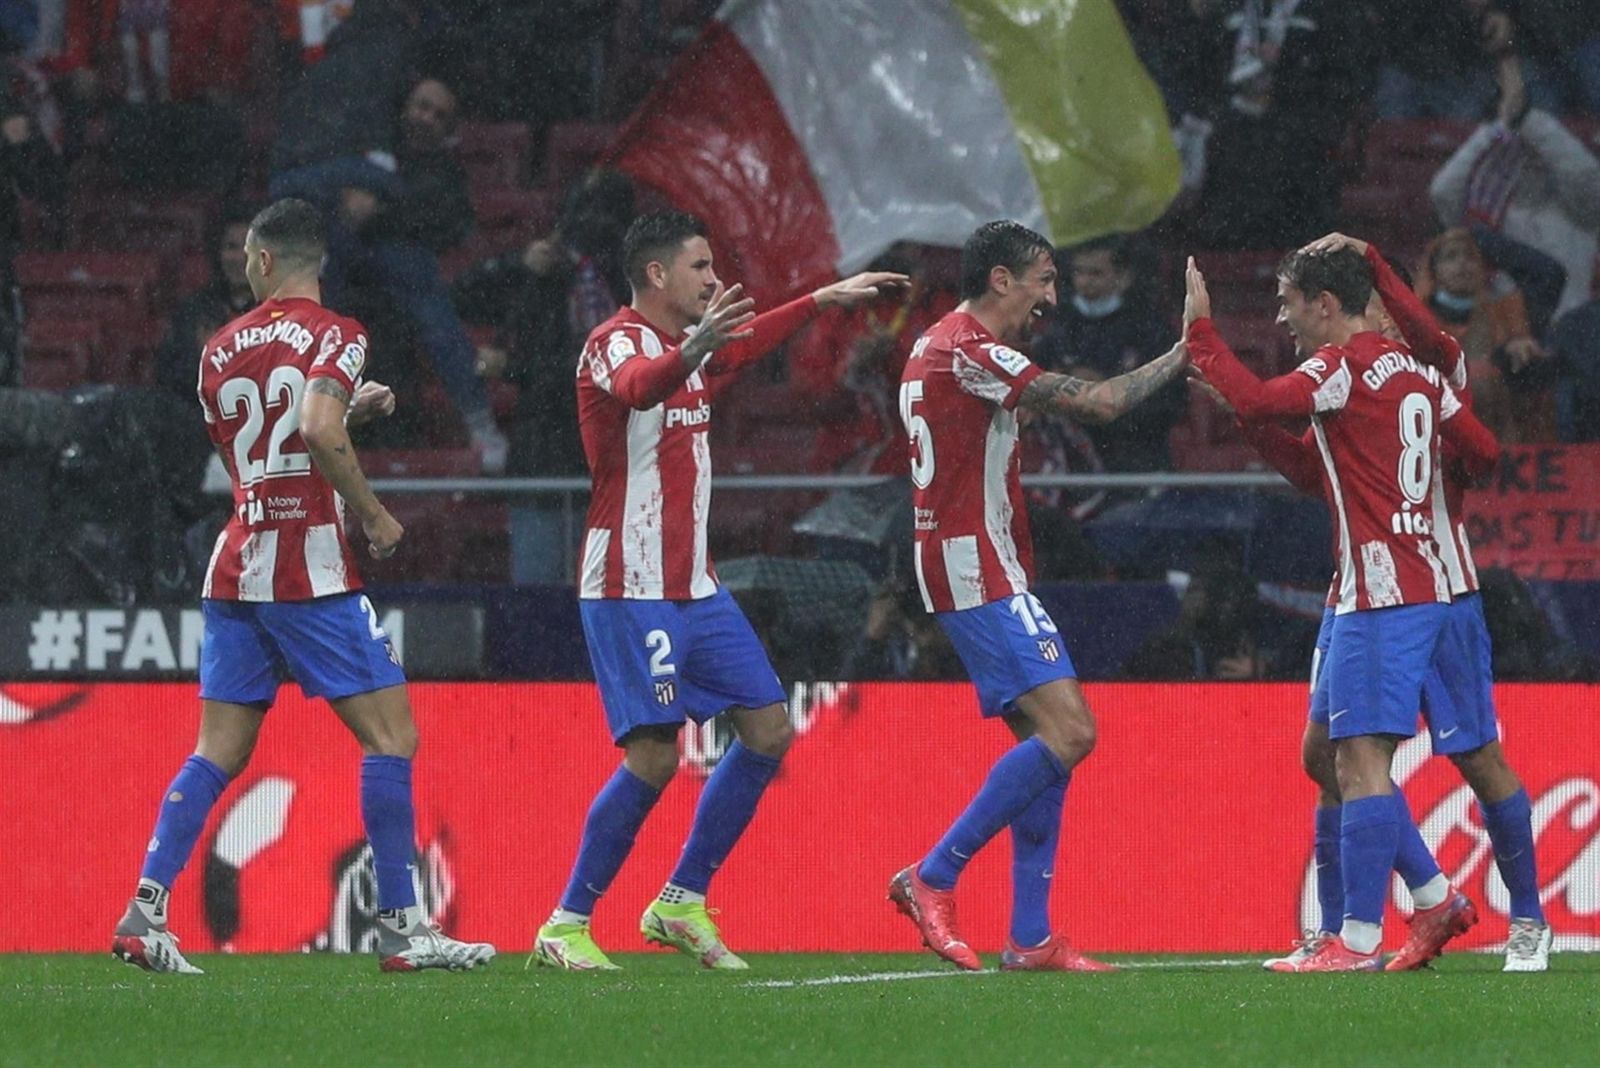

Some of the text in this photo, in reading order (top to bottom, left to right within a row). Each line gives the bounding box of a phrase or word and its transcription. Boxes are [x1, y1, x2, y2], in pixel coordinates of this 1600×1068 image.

[210, 320, 314, 374] M. HERMOSO
[217, 365, 311, 488] 22
[1398, 392, 1434, 504] 8
[267, 496, 303, 511] Money
[268, 508, 308, 521] Transfer
[1009, 593, 1059, 637] 15
[645, 628, 676, 677] 2
